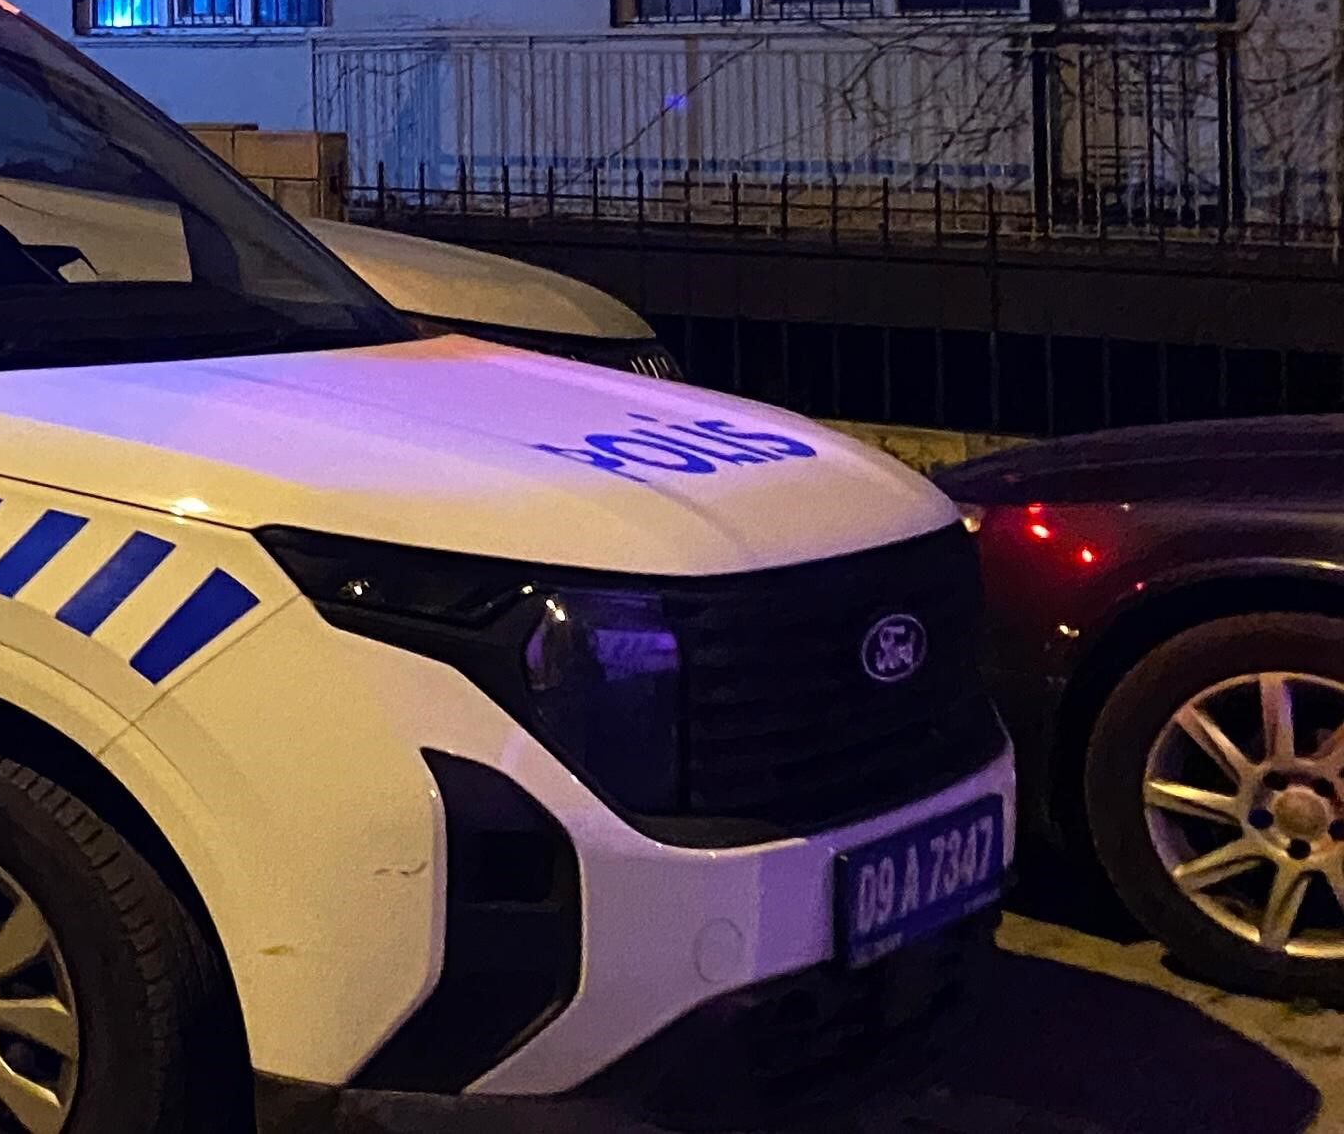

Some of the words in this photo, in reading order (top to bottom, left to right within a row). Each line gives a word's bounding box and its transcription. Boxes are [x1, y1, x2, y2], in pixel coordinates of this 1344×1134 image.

[528, 412, 817, 483] POLİS
[857, 856, 895, 933] 09
[900, 844, 920, 917] A
[929, 816, 994, 904] 7347
